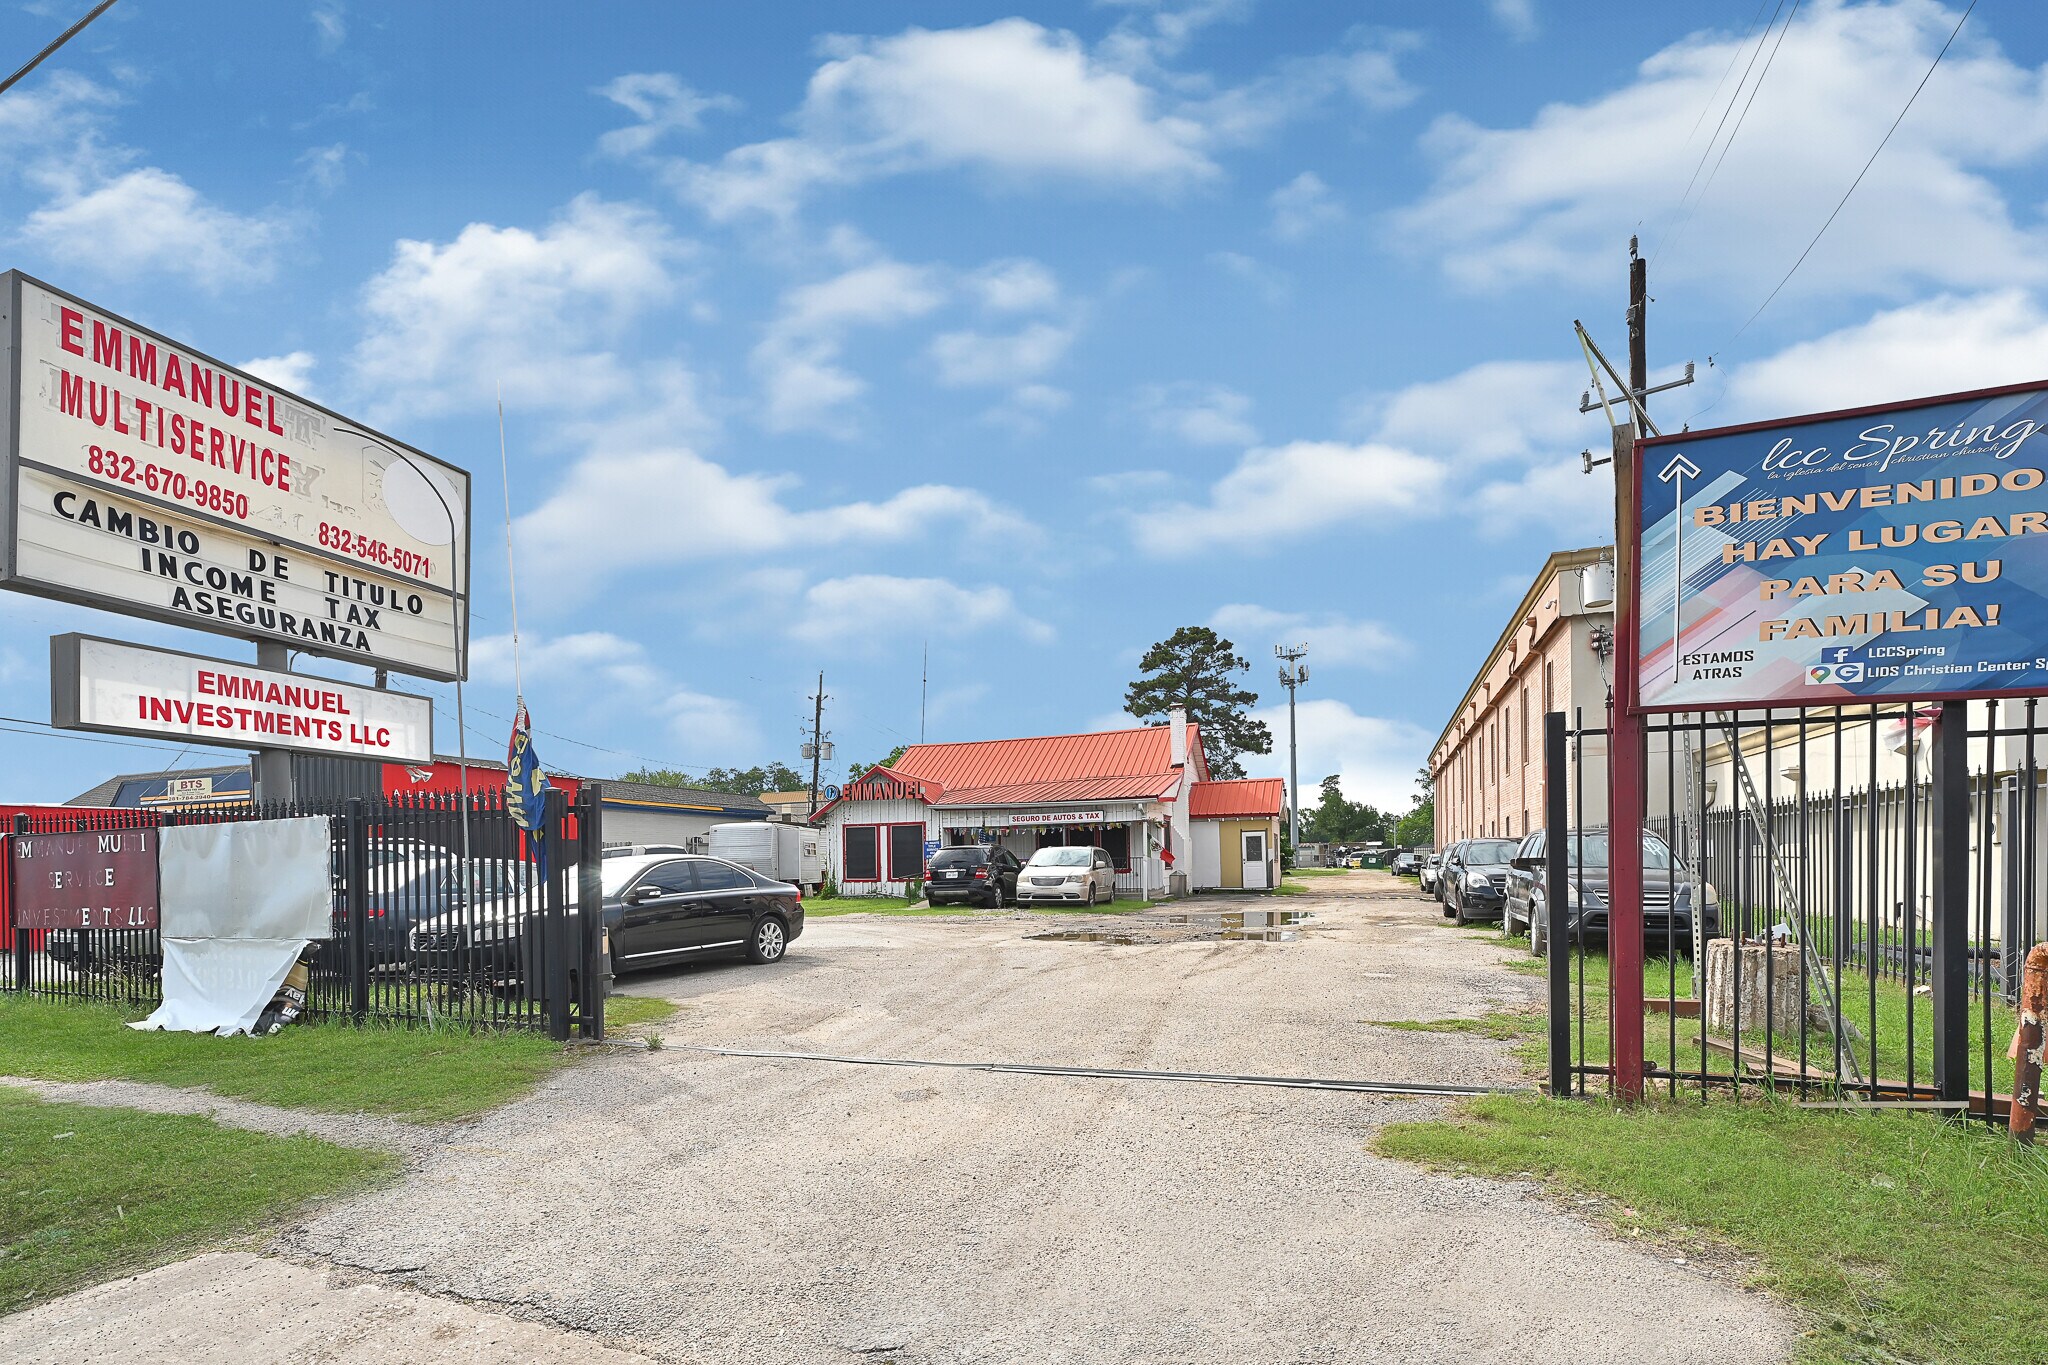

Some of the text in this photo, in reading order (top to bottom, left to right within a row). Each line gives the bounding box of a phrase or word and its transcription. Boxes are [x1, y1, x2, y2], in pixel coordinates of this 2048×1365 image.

[60, 306, 283, 436] EMMANUEL
[60, 369, 290, 492] MULTISERVICE
[1843, 419, 2047, 473] Spring
[88, 445, 248, 520] 832-670-9850
[1784, 466, 1824, 481] iglesia
[1826, 461, 1846, 474] del
[1891, 451, 1950, 465] christian
[1951, 444, 2000, 457] church
[54, 491, 199, 555] CAMBIO
[249, 549, 289, 580] DE
[325, 570, 423, 615] TITULO
[319, 522, 430, 578] 832-546-5071
[1722, 511, 2048, 564] HAY LUGAR
[142, 549, 380, 630] INCOME TAX
[1759, 560, 2002, 601] PARA SU
[172, 587, 371, 652] ASEGURANZA
[1759, 603, 2002, 642] FAMILIA!
[1683, 650, 1754, 681] ESTAMOS ATRAS
[1867, 665, 1900, 678] LIDS
[1904, 662, 1975, 676] Christian
[1977, 661, 2030, 672] Center
[1868, 645, 1946, 660] LCCSpring
[198, 670, 350, 716] EMMANUEL
[139, 695, 390, 748] INVESTMENTS LLC
[181, 780, 203, 789] BTS
[843, 781, 922, 801] EMMANUEL
[1012, 815, 1040, 823] SEGURO
[1085, 812, 1100, 820] TAX
